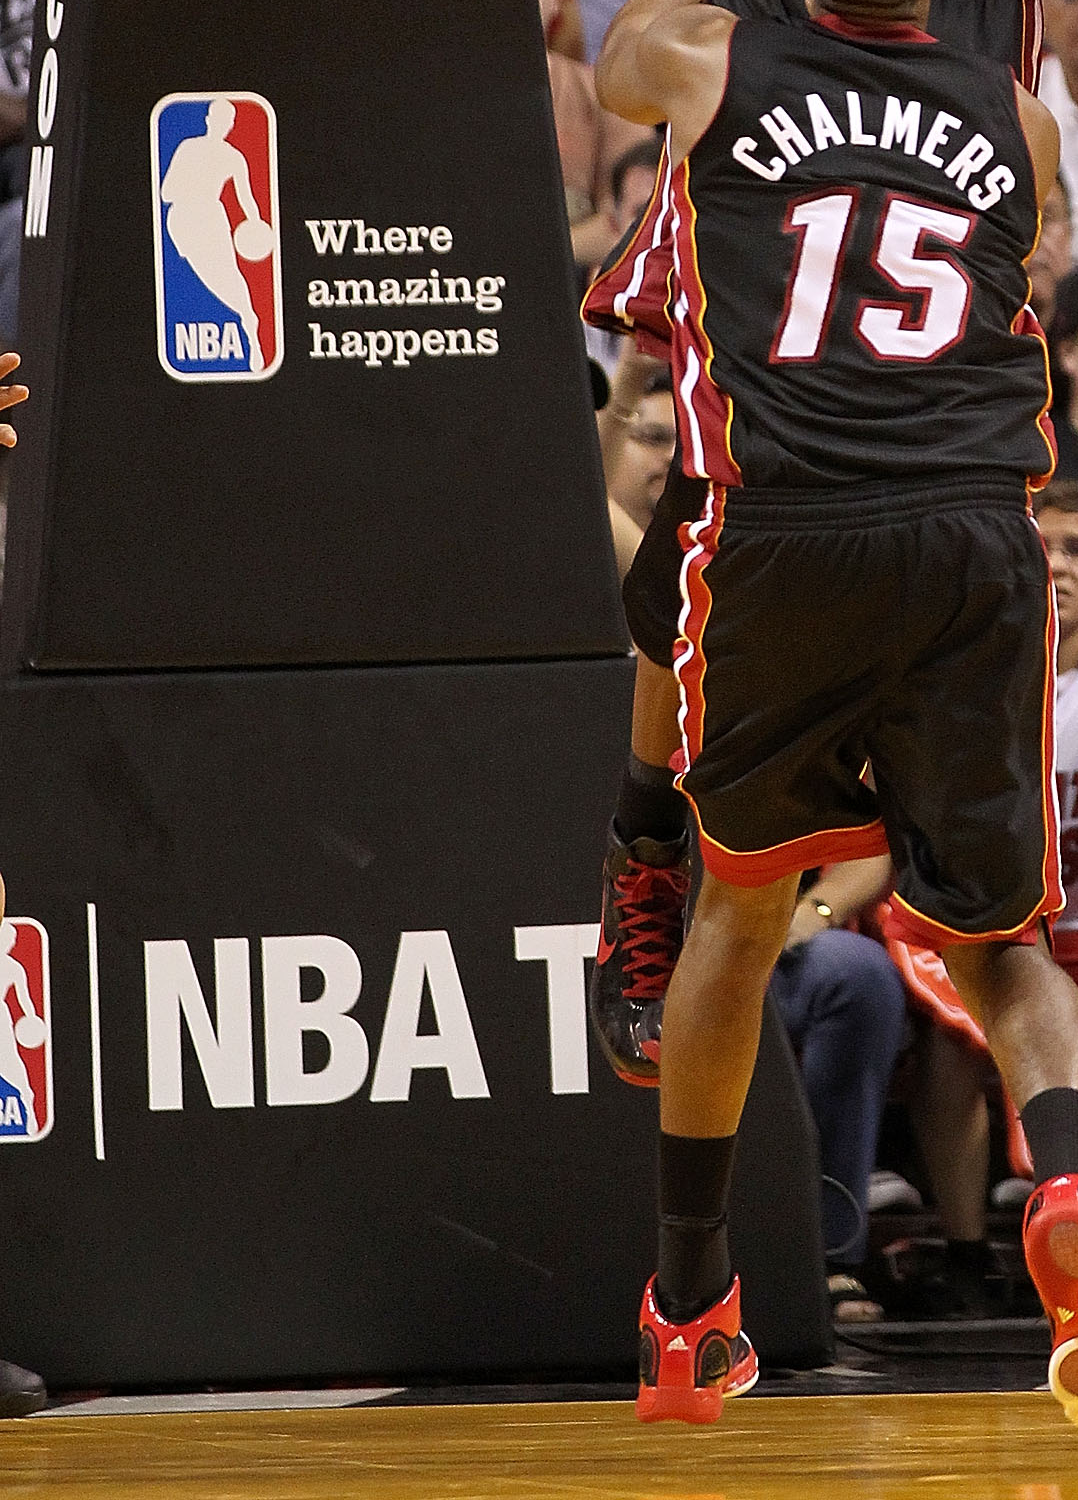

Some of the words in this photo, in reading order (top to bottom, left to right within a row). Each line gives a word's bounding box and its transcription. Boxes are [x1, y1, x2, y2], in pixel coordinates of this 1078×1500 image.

[732, 90, 1017, 212] CHALMERS
[304, 219, 454, 256] Where
[306, 267, 507, 313] amazing
[768, 185, 979, 364] 15
[174, 321, 246, 362] NBA
[307, 321, 500, 368] happens
[143, 930, 492, 1112] NBA
